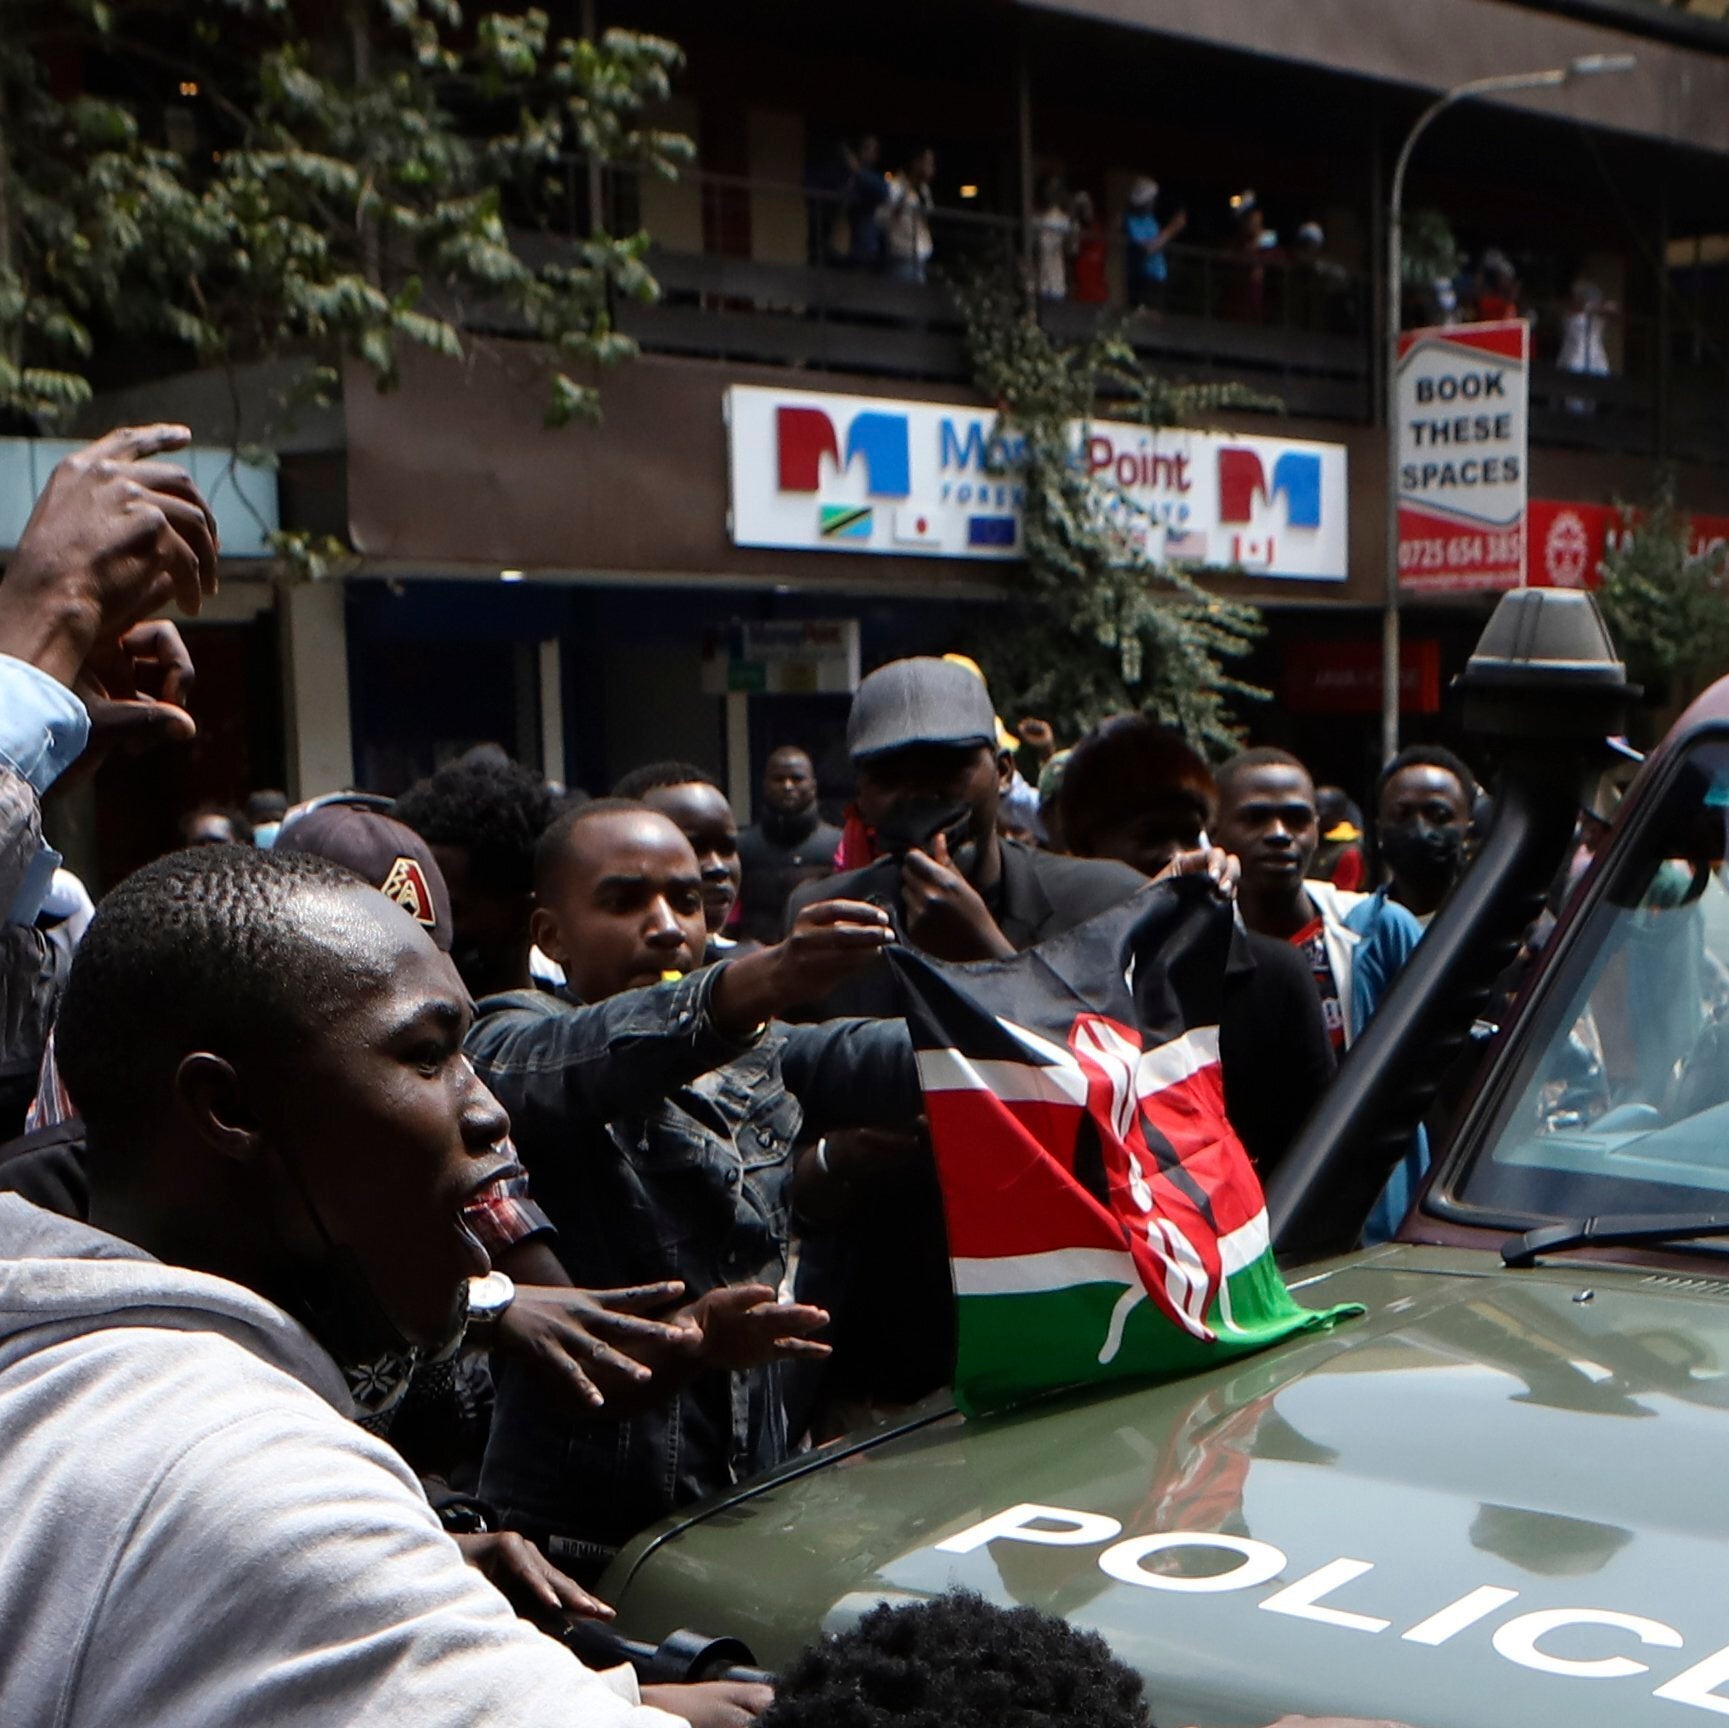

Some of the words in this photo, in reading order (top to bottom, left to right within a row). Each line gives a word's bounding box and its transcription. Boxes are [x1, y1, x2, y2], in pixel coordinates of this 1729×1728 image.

[1417, 370, 1505, 403] BOOK
[1409, 413, 1512, 445] THESE
[1401, 456, 1520, 489] SPACES
